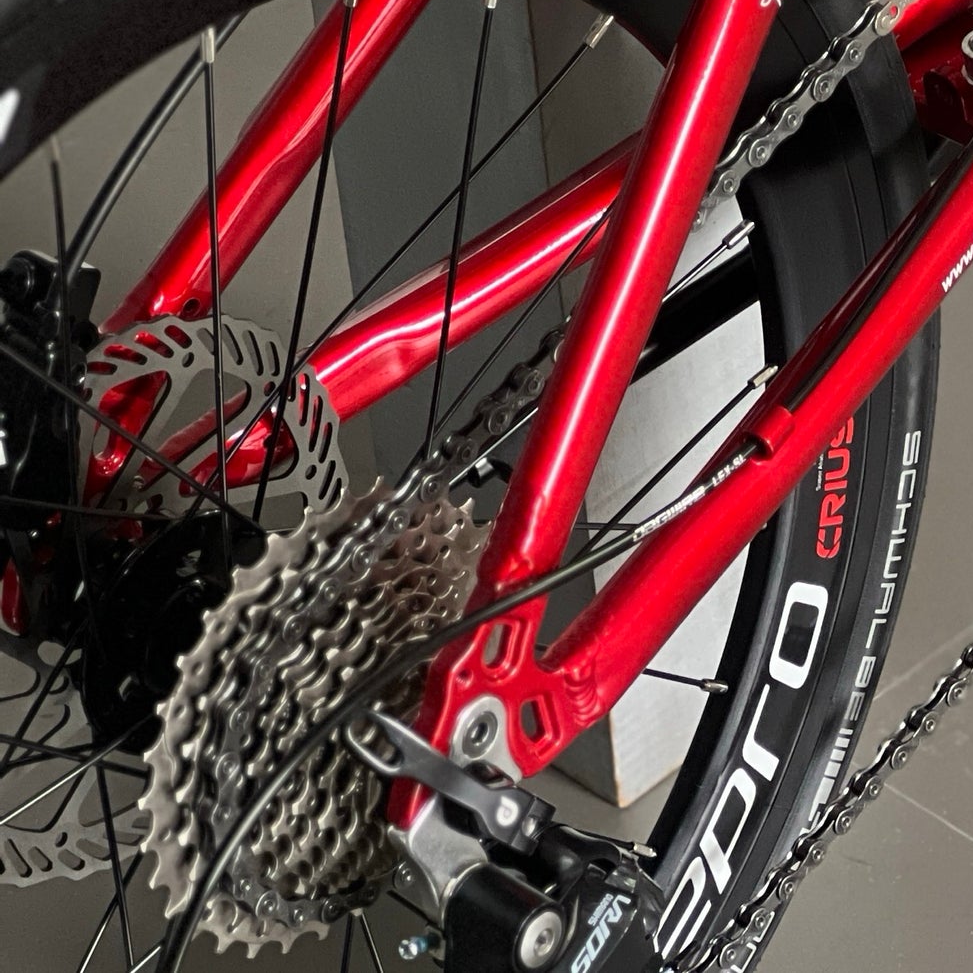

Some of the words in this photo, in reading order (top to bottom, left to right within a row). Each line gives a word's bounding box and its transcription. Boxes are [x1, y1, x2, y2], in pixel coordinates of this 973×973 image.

[816, 416, 855, 559] CRIUS
[843, 430, 922, 722] SCHWALBE
[570, 894, 632, 973] SORA
